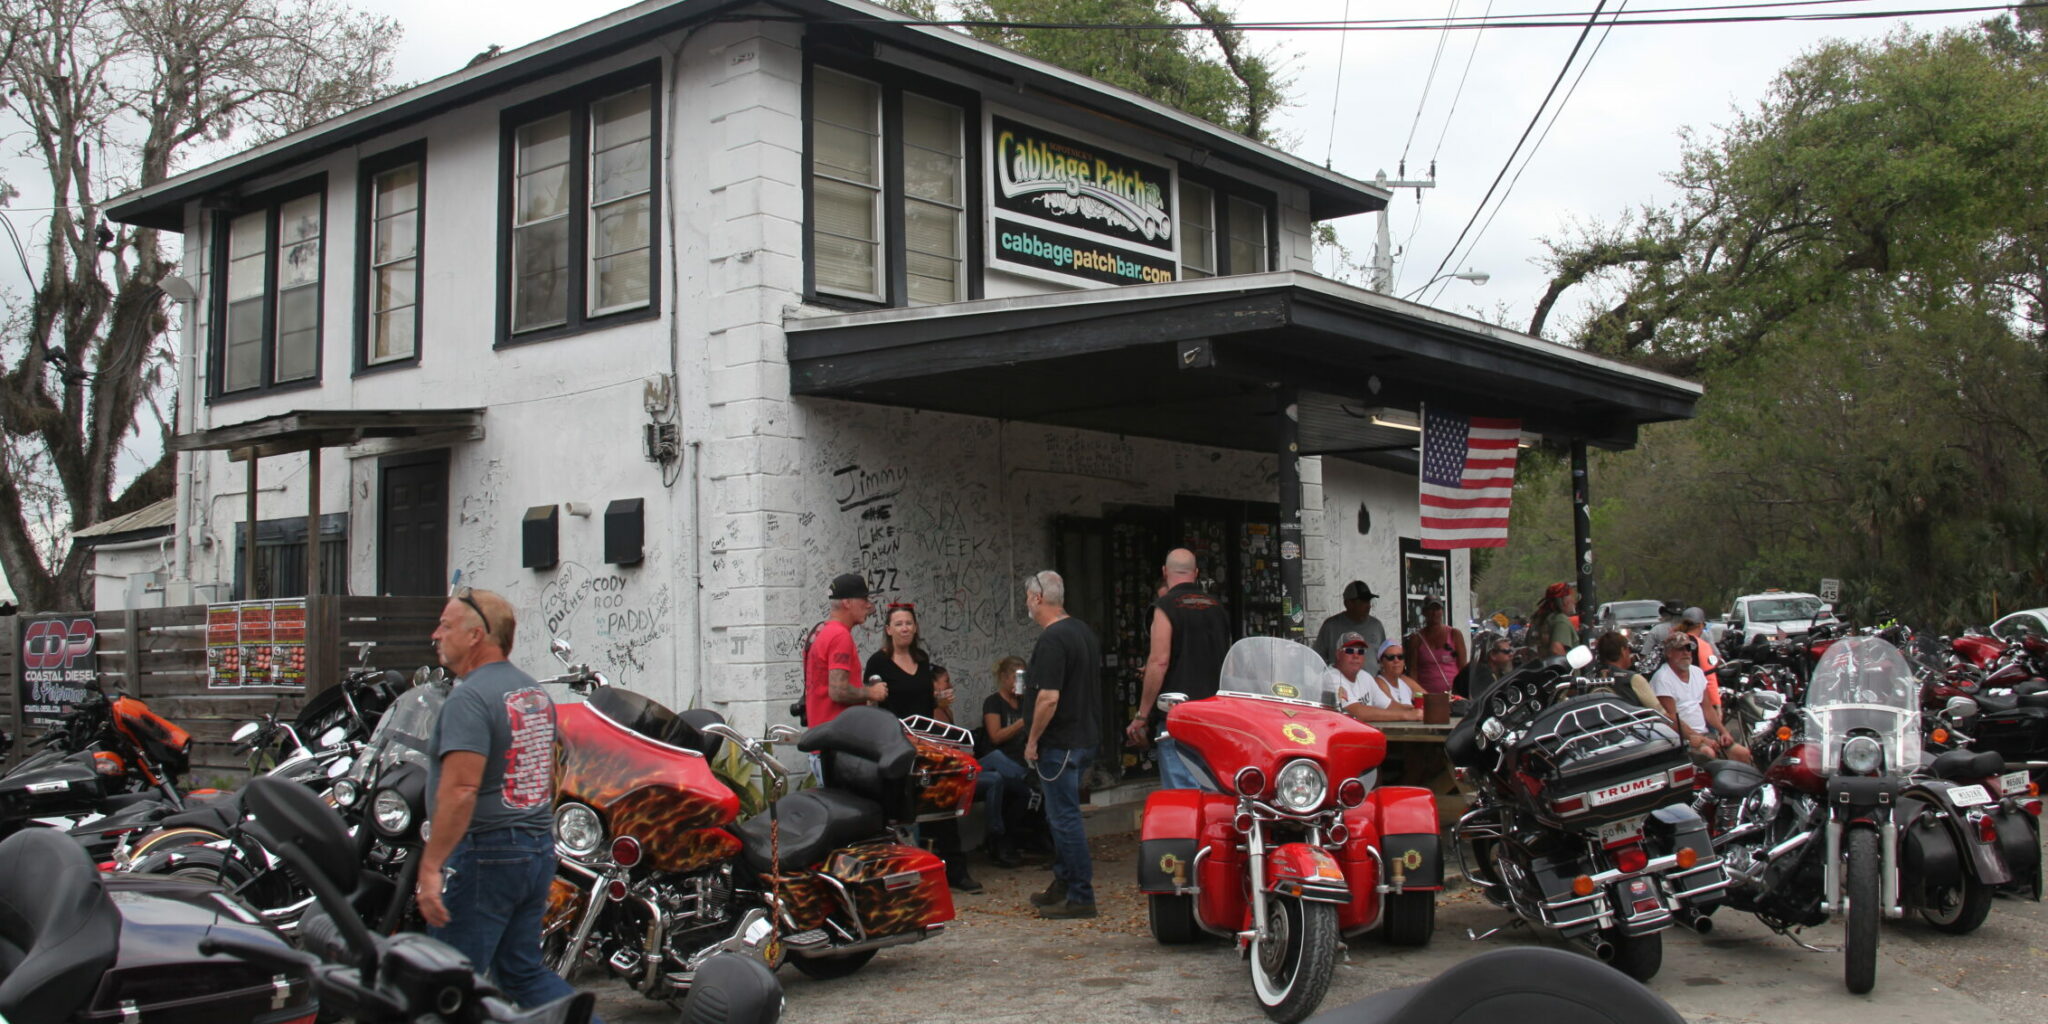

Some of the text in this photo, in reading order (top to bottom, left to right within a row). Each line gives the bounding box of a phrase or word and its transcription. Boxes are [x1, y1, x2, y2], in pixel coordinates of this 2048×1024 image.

[998, 131, 1146, 210] Cabbage Patch
[1001, 232, 1172, 284] cabbagepatchbar.com
[833, 464, 908, 504] Jimmy
[592, 575, 627, 592] CODY
[1821, 590, 1837, 600] 45
[594, 593, 624, 609] ROO
[608, 608, 659, 635] PADDY
[24, 619, 96, 669] CDP
[25, 668, 96, 681] COASTAL DIESEL
[1597, 778, 1654, 799] TRUMP
